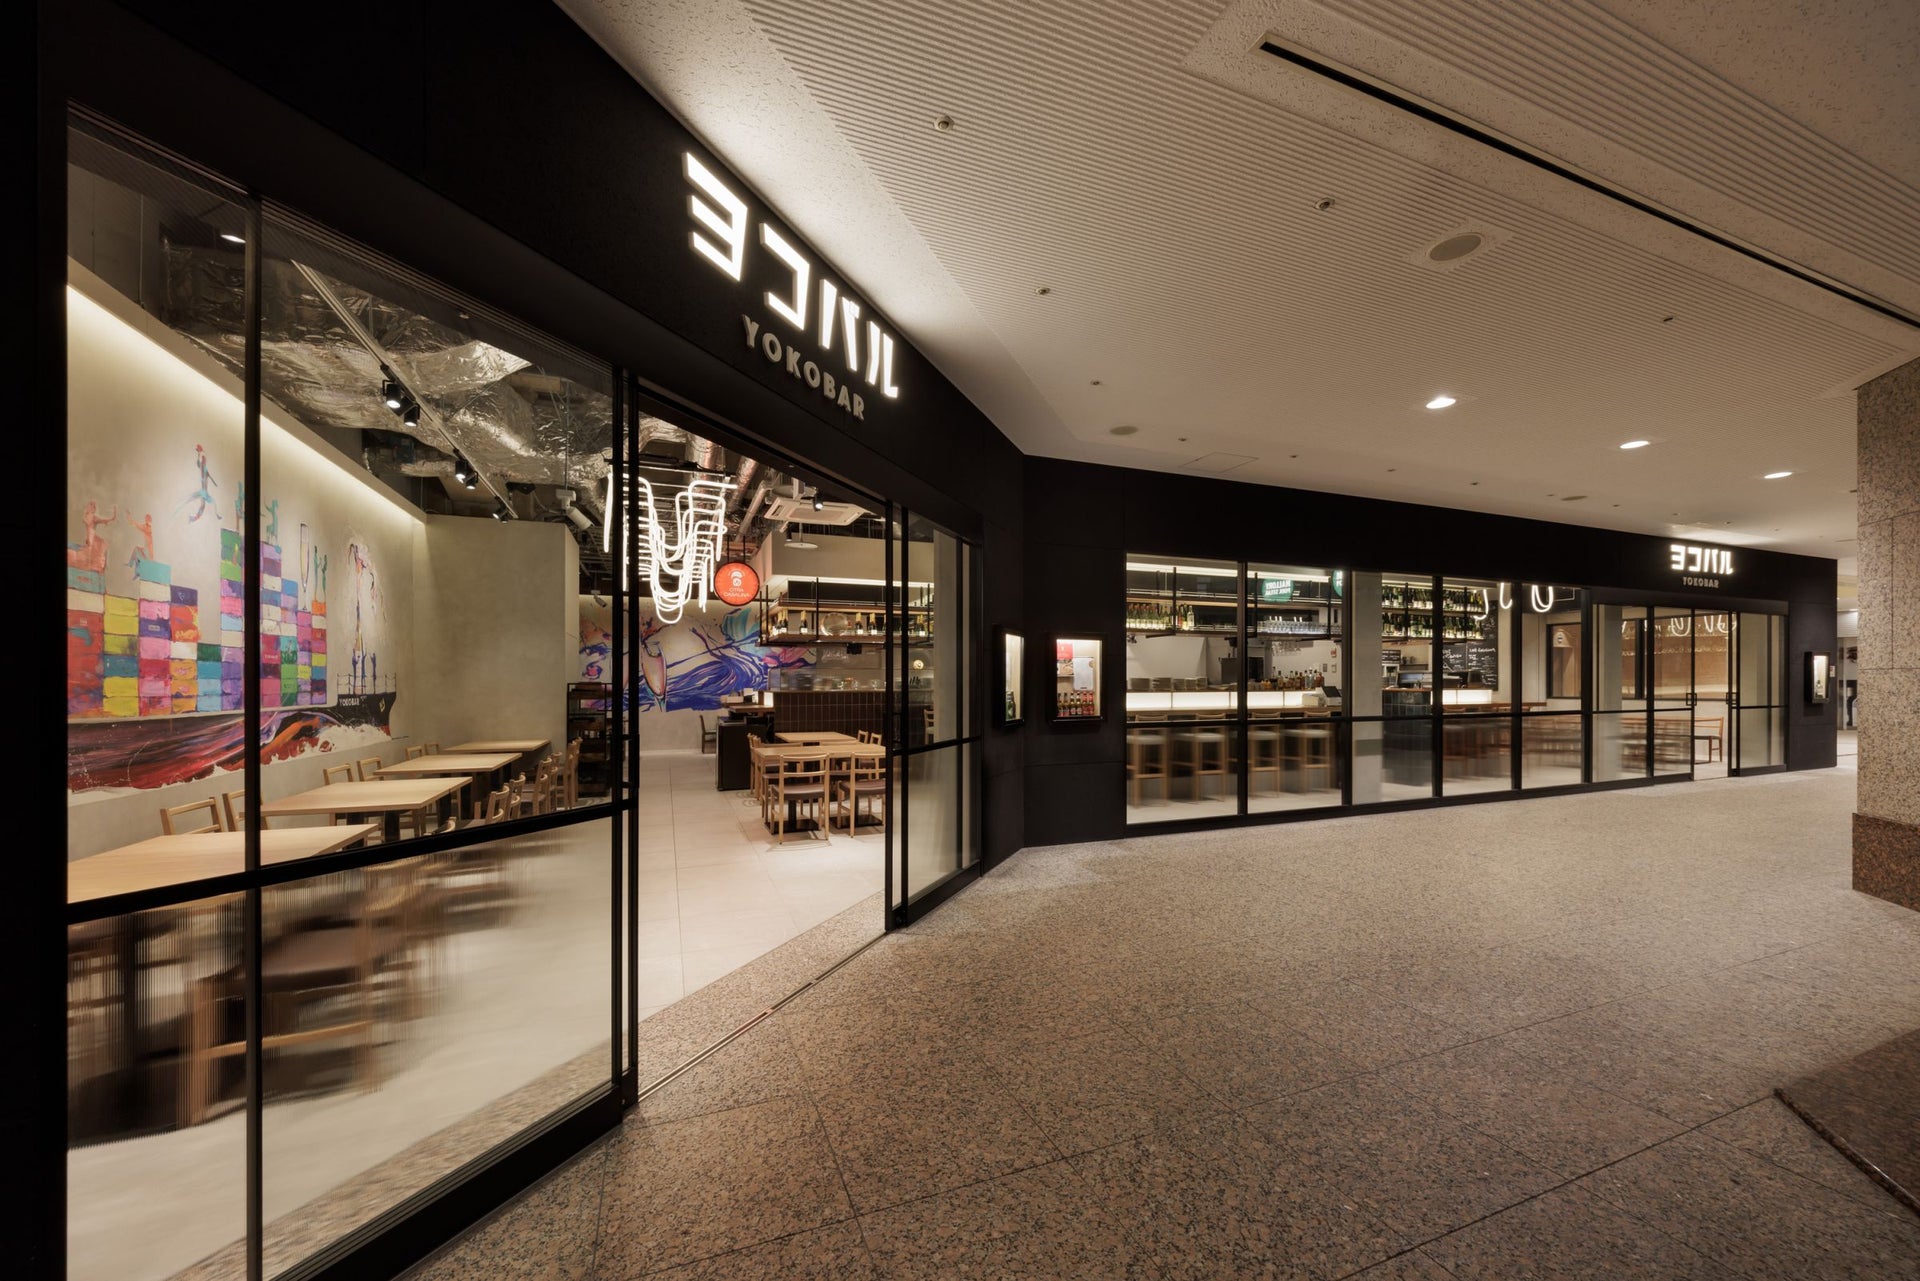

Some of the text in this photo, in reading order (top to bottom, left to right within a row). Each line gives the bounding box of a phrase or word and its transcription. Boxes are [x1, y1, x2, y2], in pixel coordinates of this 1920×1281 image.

[682, 151, 899, 399] ヨコバル
[742, 313, 865, 421] YOKOBAR
[1670, 544, 1734, 575] ヨコバル
[1682, 577, 1719, 588] YOKOBAR
